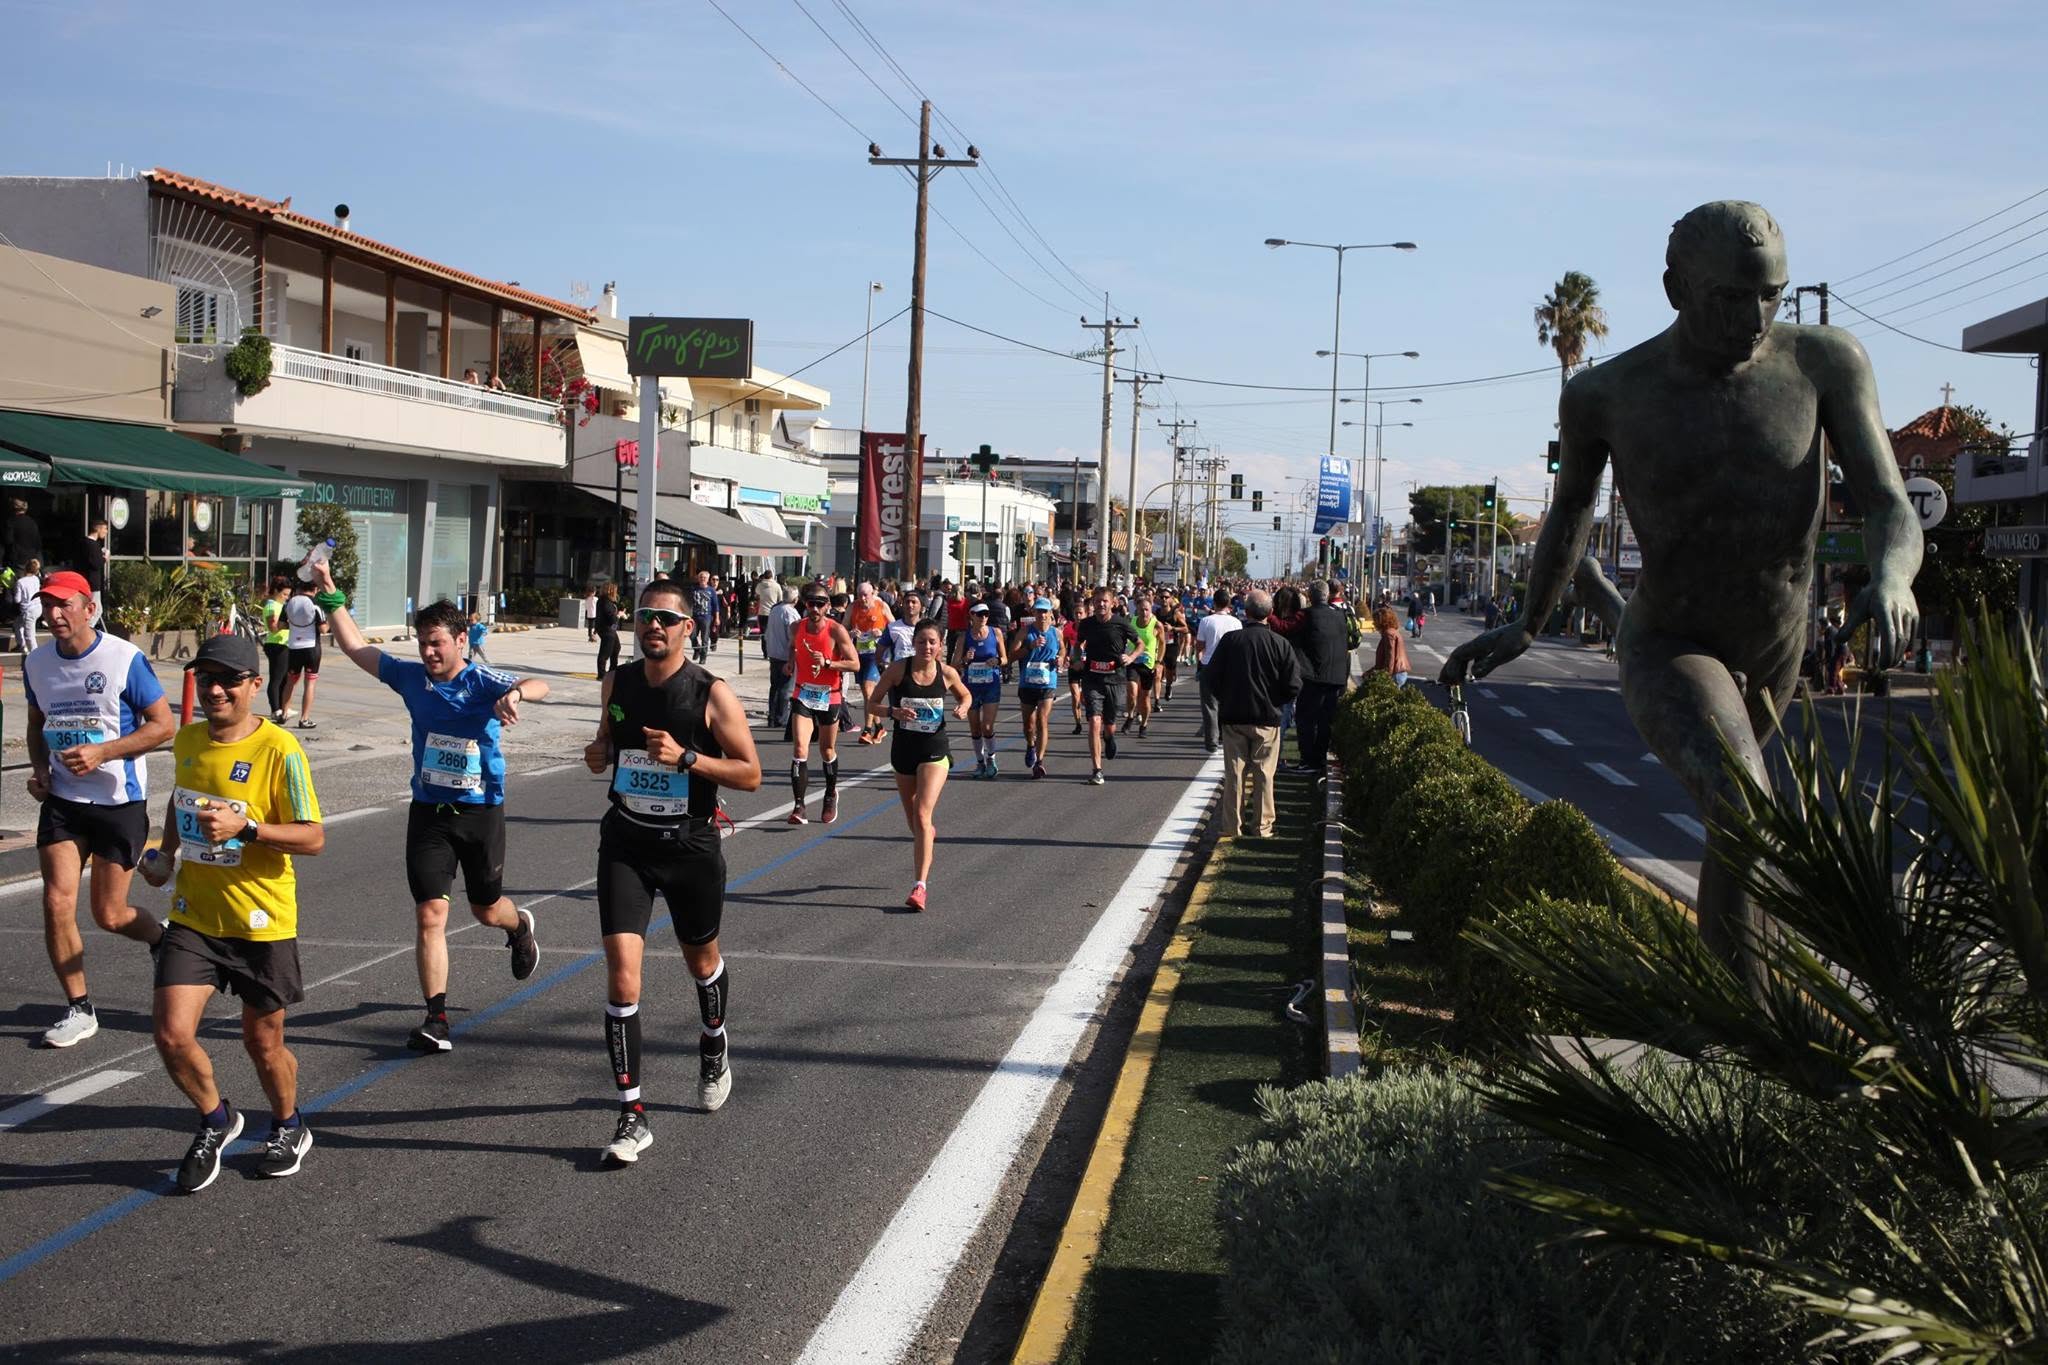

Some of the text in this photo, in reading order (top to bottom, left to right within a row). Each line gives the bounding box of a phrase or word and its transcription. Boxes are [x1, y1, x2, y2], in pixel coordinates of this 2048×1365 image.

[637, 323, 740, 369] Γρηγόρης
[878, 443, 905, 562] everest
[437, 751, 468, 769] 2860
[630, 771, 670, 791] 3525
